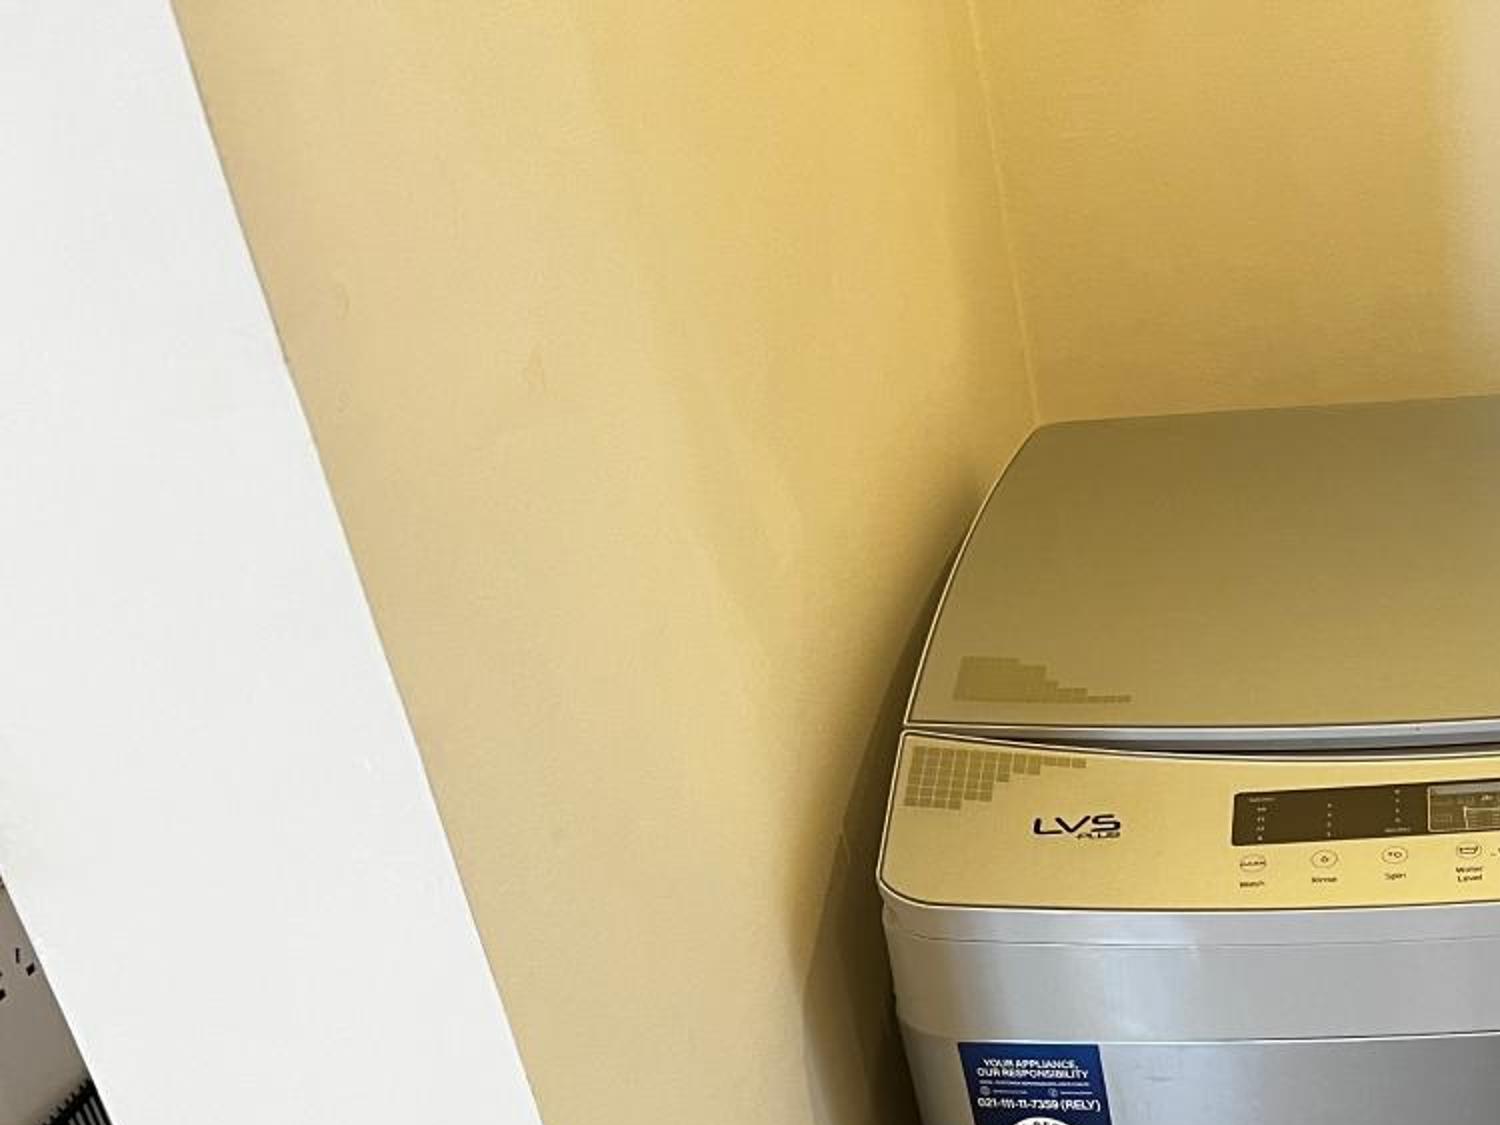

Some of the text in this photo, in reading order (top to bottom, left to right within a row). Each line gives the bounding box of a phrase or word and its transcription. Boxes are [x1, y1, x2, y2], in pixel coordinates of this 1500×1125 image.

[1033, 813, 1121, 835] LVS
[977, 1067, 1089, 1079] OUR RESPONSIBILITY
[1061, 1099, 1102, 1112] (RELY)
